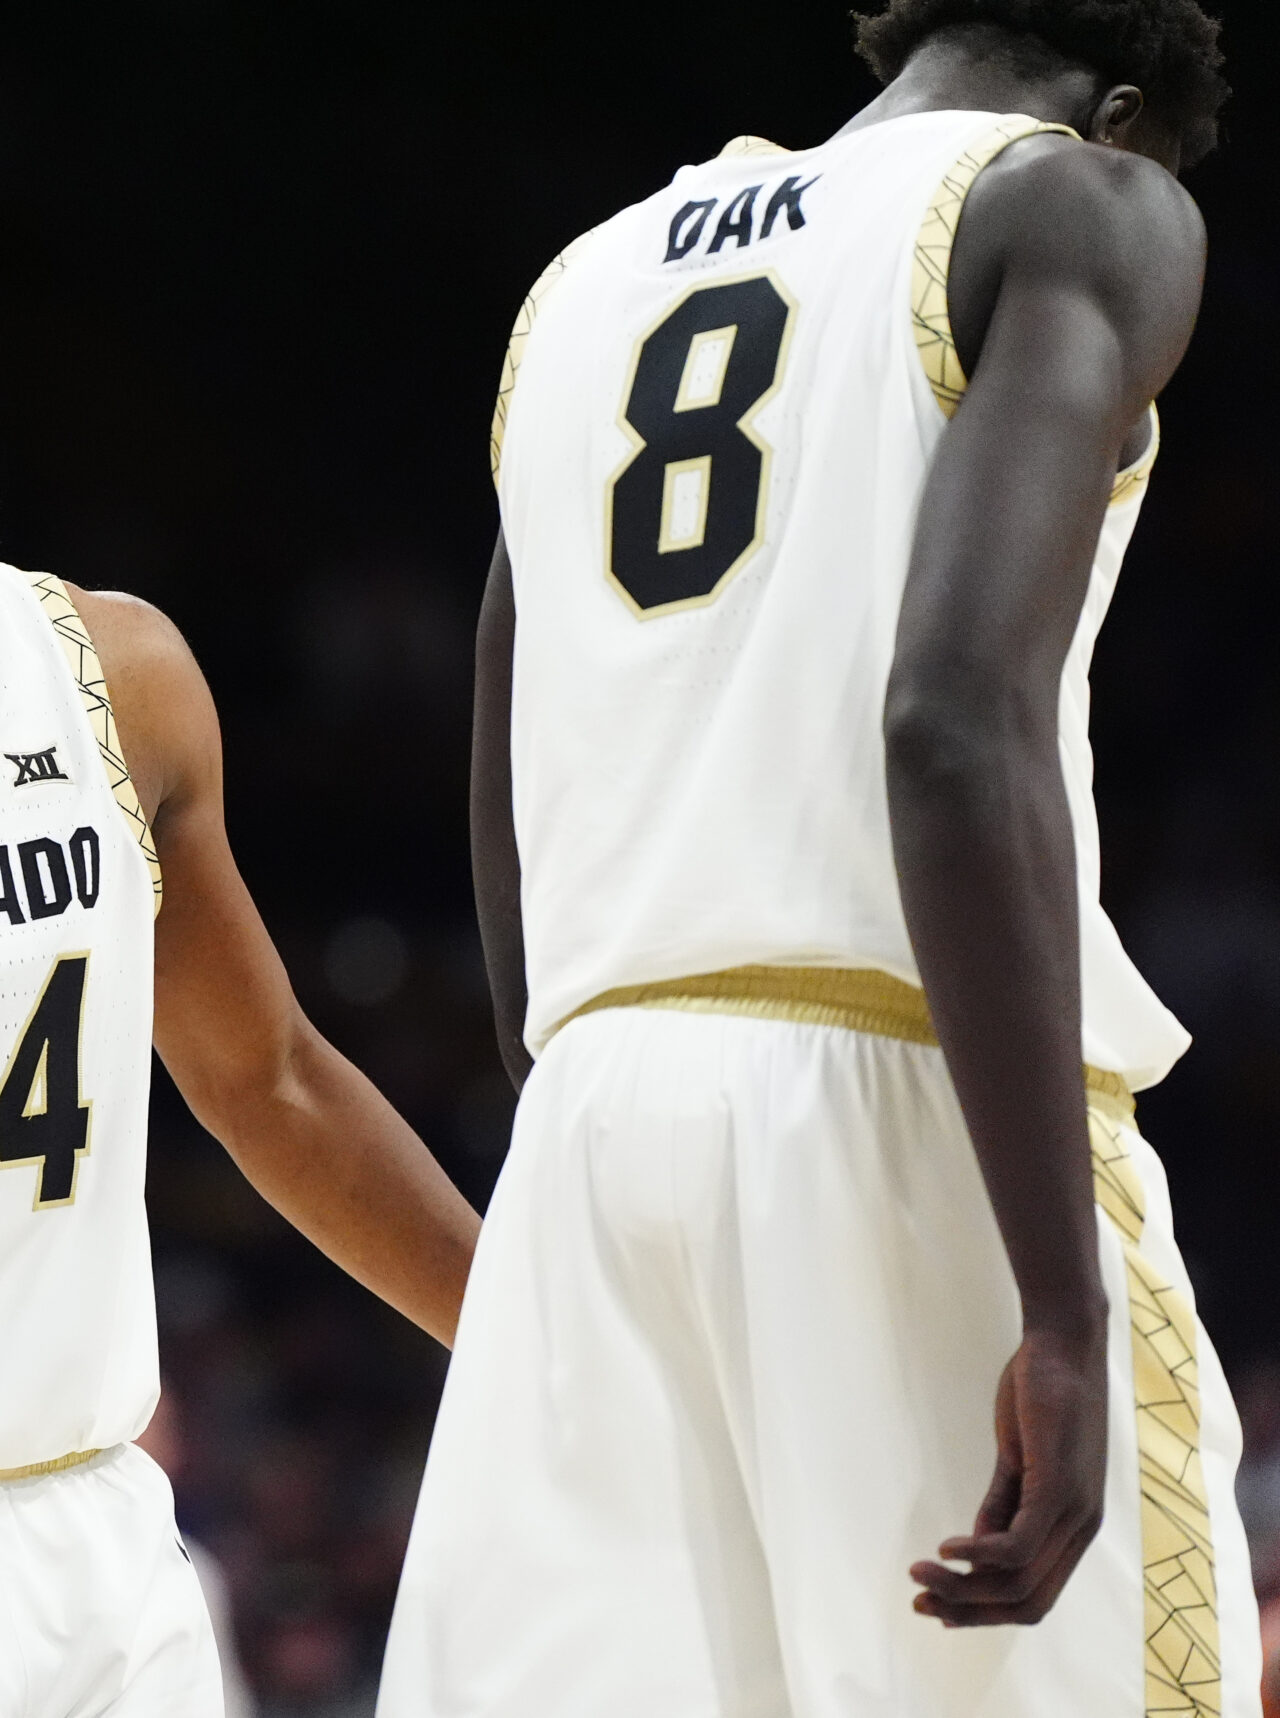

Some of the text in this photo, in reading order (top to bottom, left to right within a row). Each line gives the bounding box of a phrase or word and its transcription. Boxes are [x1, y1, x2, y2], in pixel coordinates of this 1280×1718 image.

[663, 173, 823, 264] DAK
[603, 267, 800, 623] 8
[3, 746, 69, 787] XII
